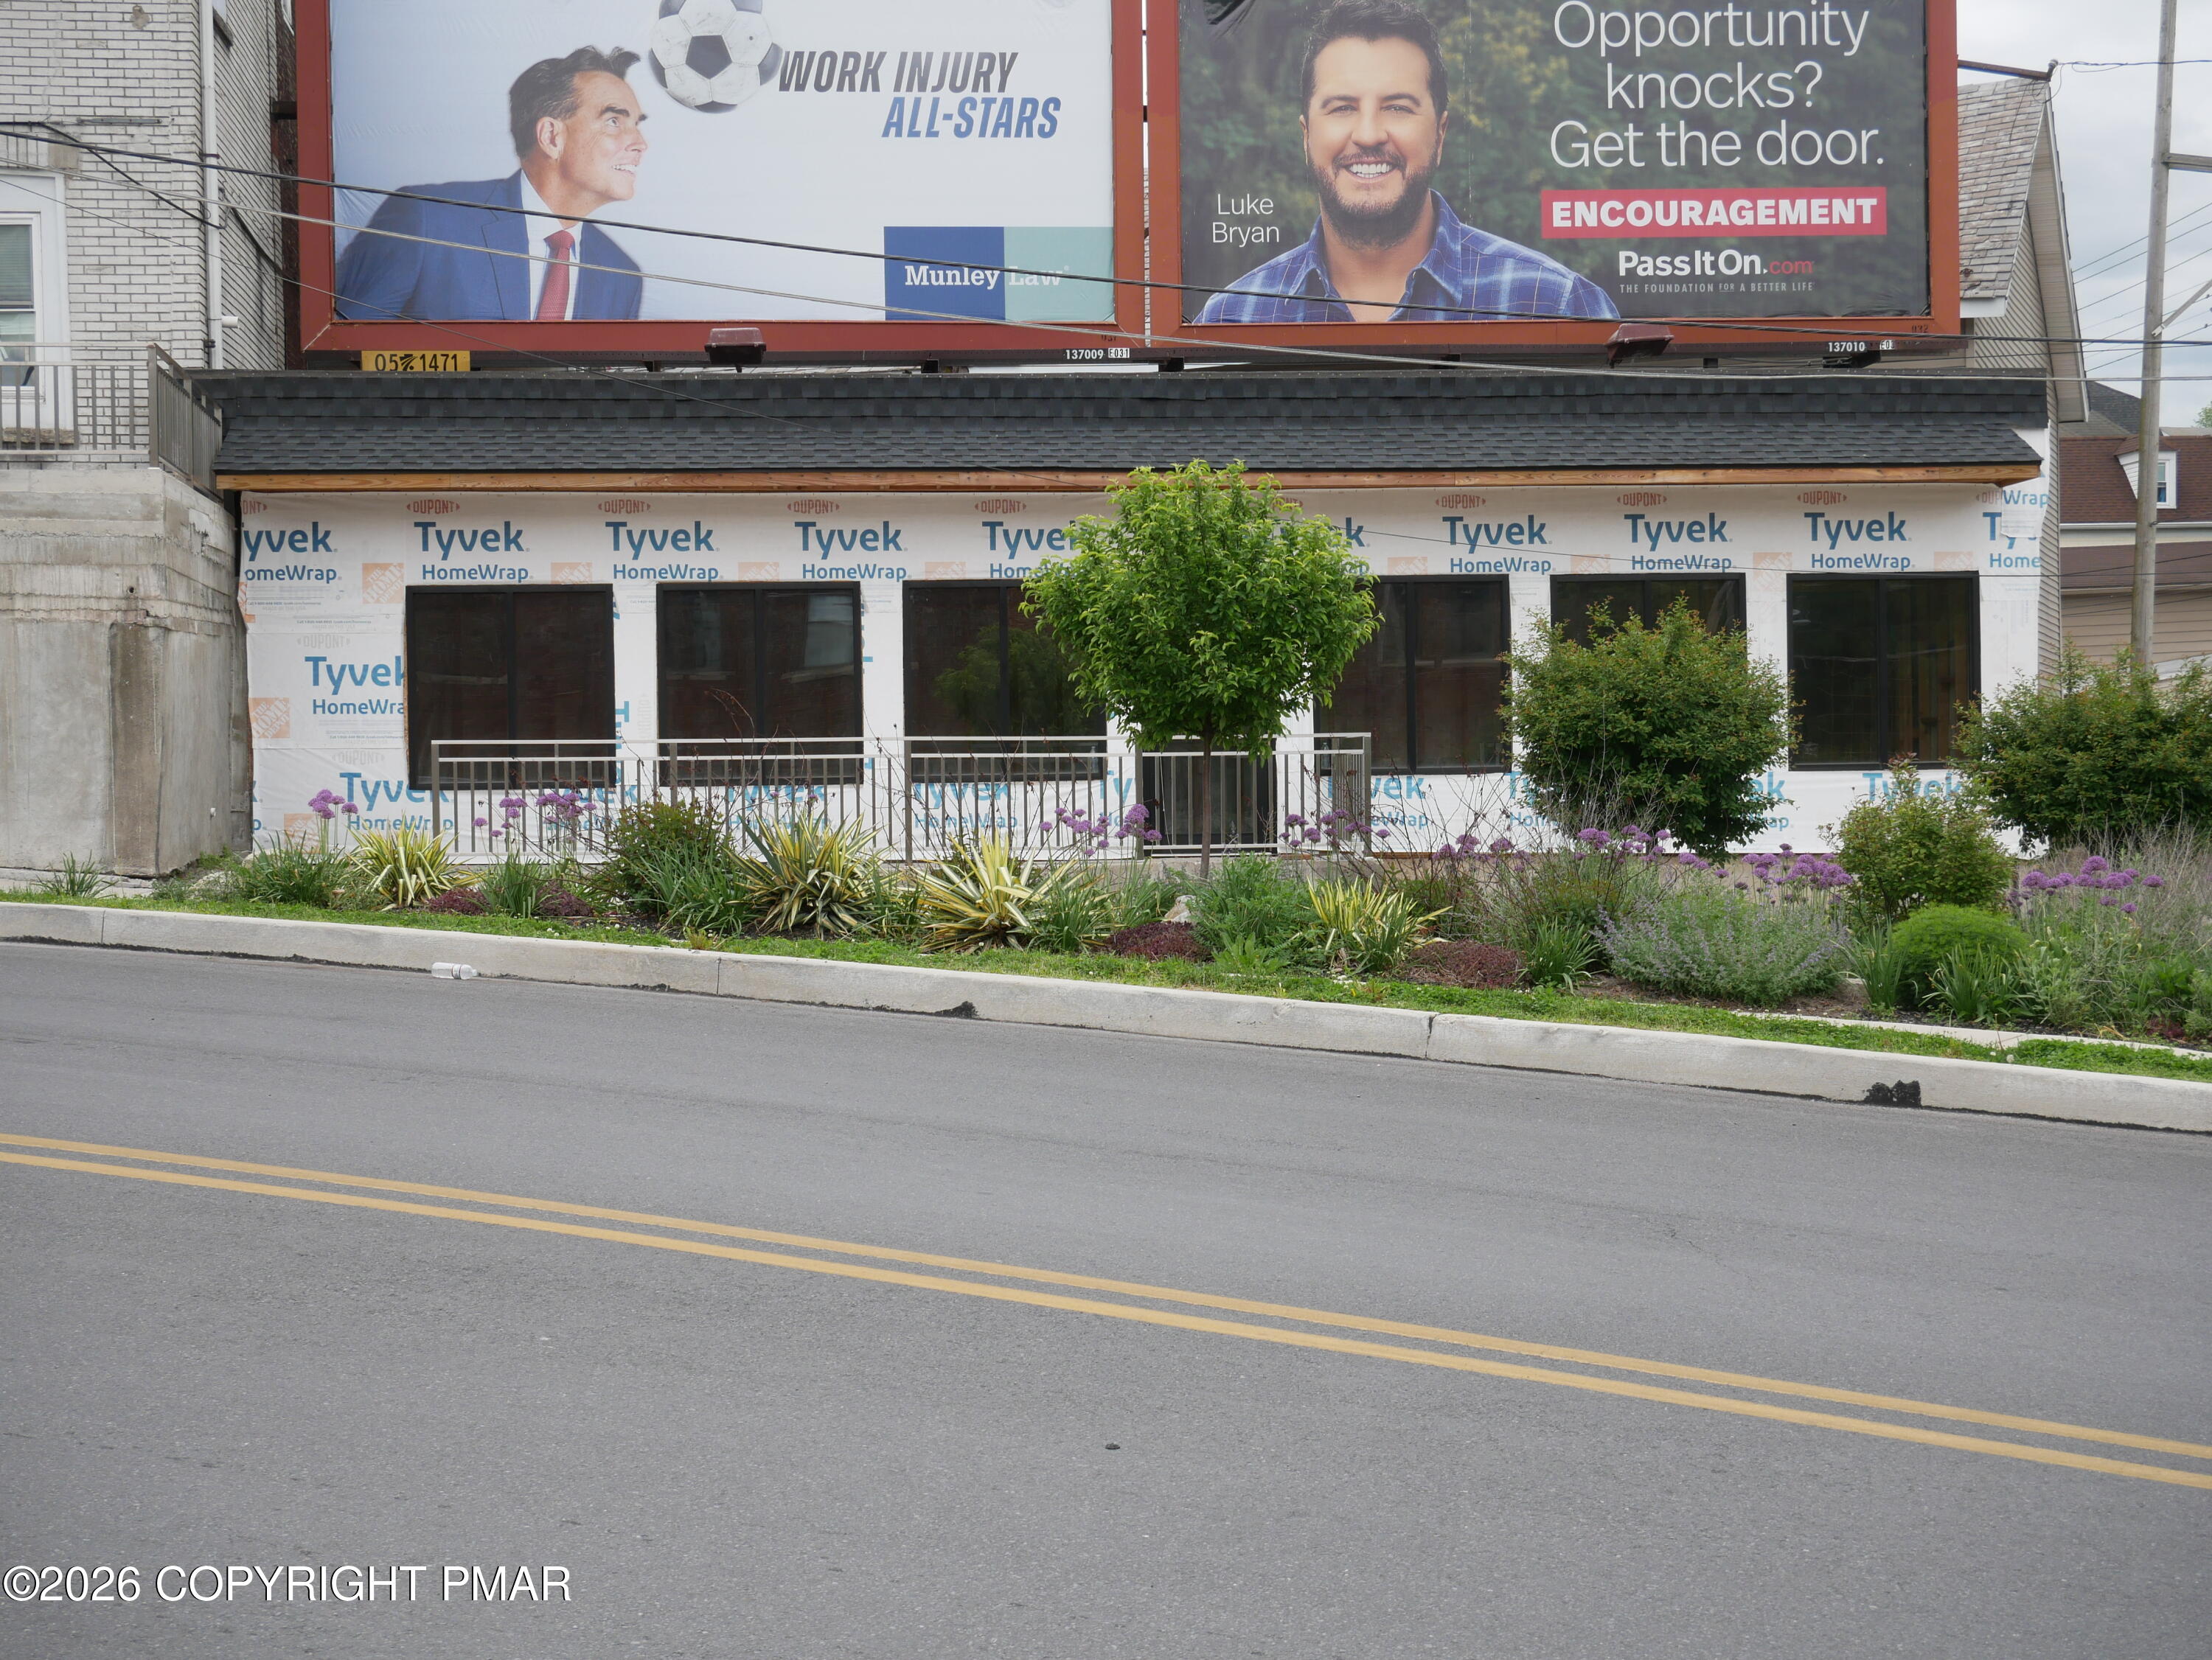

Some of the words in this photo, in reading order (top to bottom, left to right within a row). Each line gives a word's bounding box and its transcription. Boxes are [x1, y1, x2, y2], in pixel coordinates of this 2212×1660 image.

[1554, 0, 1870, 57] Opportunity
[779, 51, 888, 93] WORK
[893, 52, 1019, 93] INJURY
[1607, 60, 1823, 108] knocks?
[881, 97, 1061, 138] ALL-STARS
[1551, 120, 1645, 168] Get
[1656, 120, 1742, 167] the
[1756, 119, 1884, 166] door.
[1217, 193, 1274, 215] Luke
[1552, 198, 1877, 227] ENCOURAGEMENT
[1212, 222, 1279, 247] Bryan
[905, 265, 1001, 289] Munley
[1620, 284, 1639, 293] THE
[1645, 283, 1714, 293] FOUNDATION
[1719, 283, 1734, 291] FOR
[1739, 282, 1745, 291] A
[1750, 282, 1787, 291] BETTER
[1792, 282, 1813, 291] LIFE
[1065, 349, 1104, 360] 137009
[1828, 341, 1865, 352] 137010
[413, 499, 455, 514] DUPONT
[605, 499, 646, 514] DUPONT
[793, 499, 834, 514] DUPONT
[981, 499, 1021, 514] DUPONT
[1441, 494, 1481, 509] DUPONT
[1623, 492, 1662, 506] DUPONT
[1803, 491, 1842, 505] DUPONT
[414, 520, 524, 560] Tyvek
[605, 520, 714, 560] Tyvek
[794, 520, 903, 560] Tyvek
[1442, 515, 1547, 554] Tyvek
[1624, 512, 1728, 551] Tyvek
[1804, 512, 1907, 550] Tyvek
[242, 522, 333, 562] yvek
[1450, 557, 1551, 575] HomeWrap
[1632, 555, 1732, 572] HomeWrap
[1811, 554, 1910, 571] HomeWrap
[244, 565, 337, 584] omeWrap
[422, 564, 529, 583] HomeWrap
[613, 564, 719, 582] HomeWrap
[802, 564, 907, 582] HomeWrap
